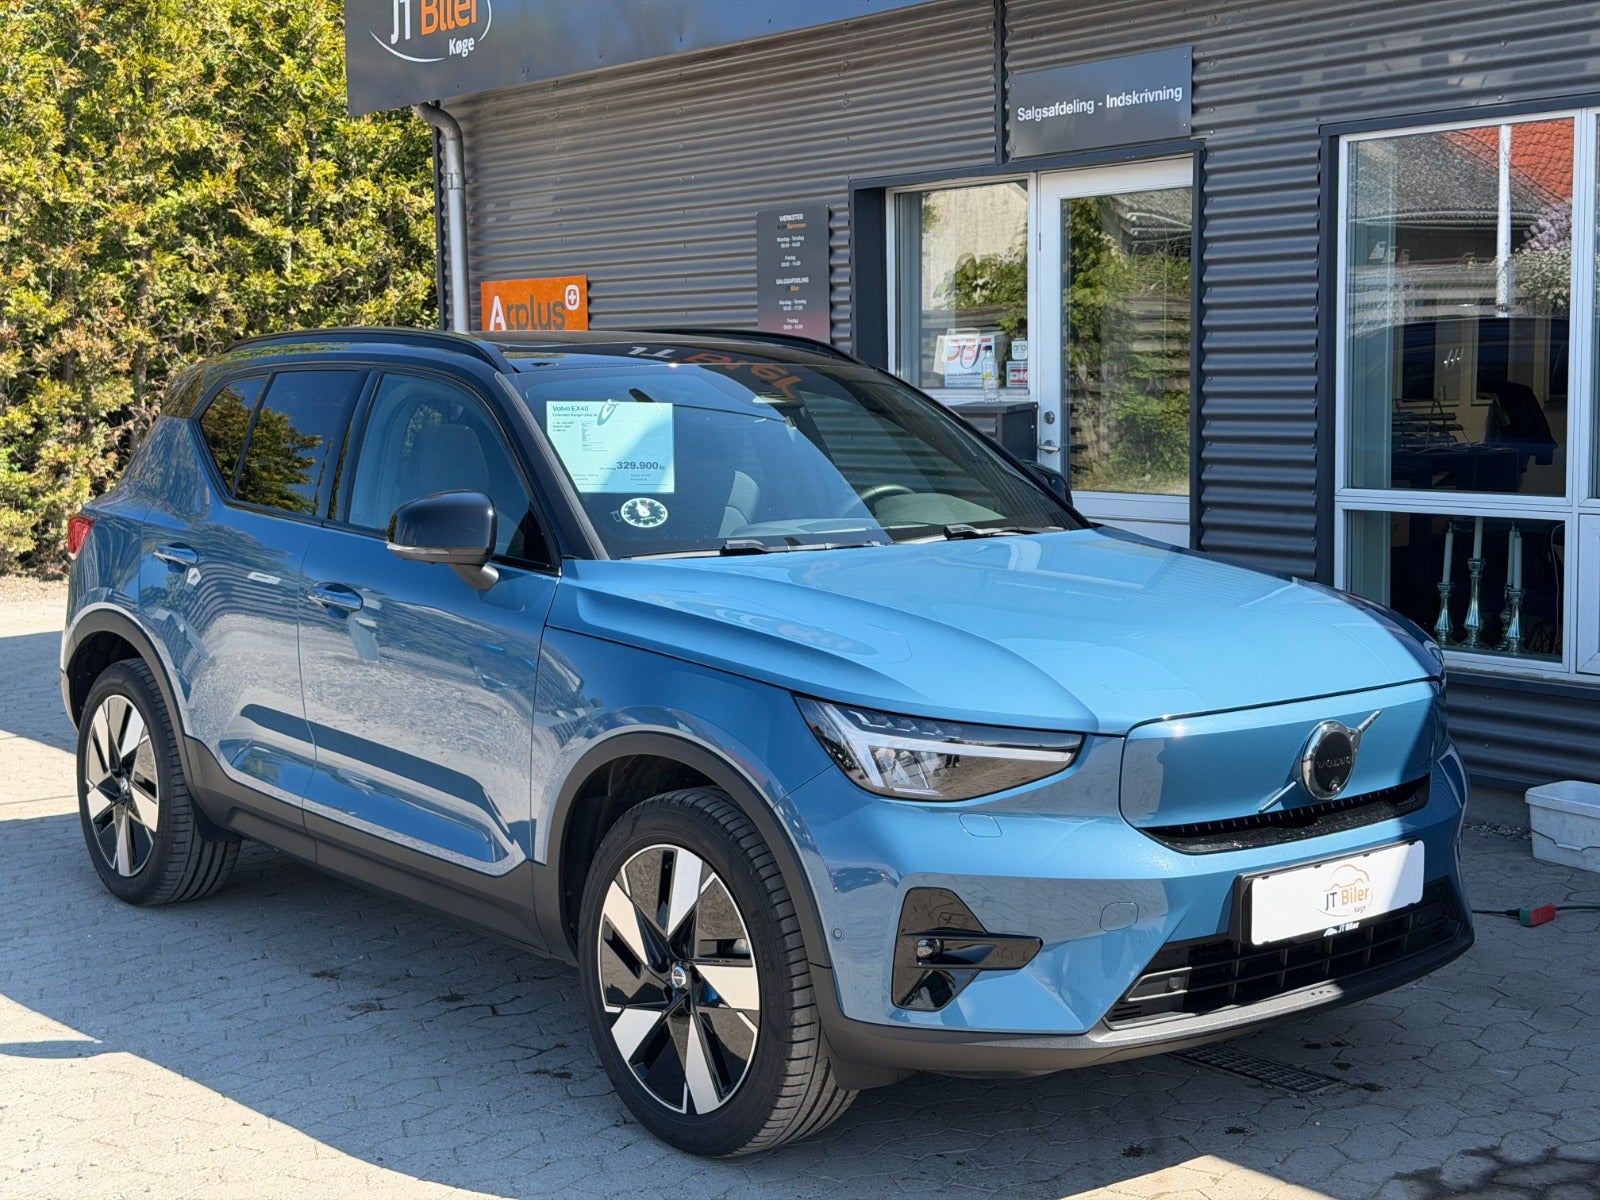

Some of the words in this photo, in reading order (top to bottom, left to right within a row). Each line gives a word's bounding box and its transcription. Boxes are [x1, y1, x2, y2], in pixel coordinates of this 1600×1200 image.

[421, 0, 477, 35] Biler
[449, 37, 475, 58] Køge
[1017, 98, 1095, 122] Salgsafdeling
[1106, 86, 1183, 109] Indskrivning
[616, 461, 659, 470] 329.900
[1324, 891, 1338, 912] JT
[1341, 886, 1370, 906] Biler
